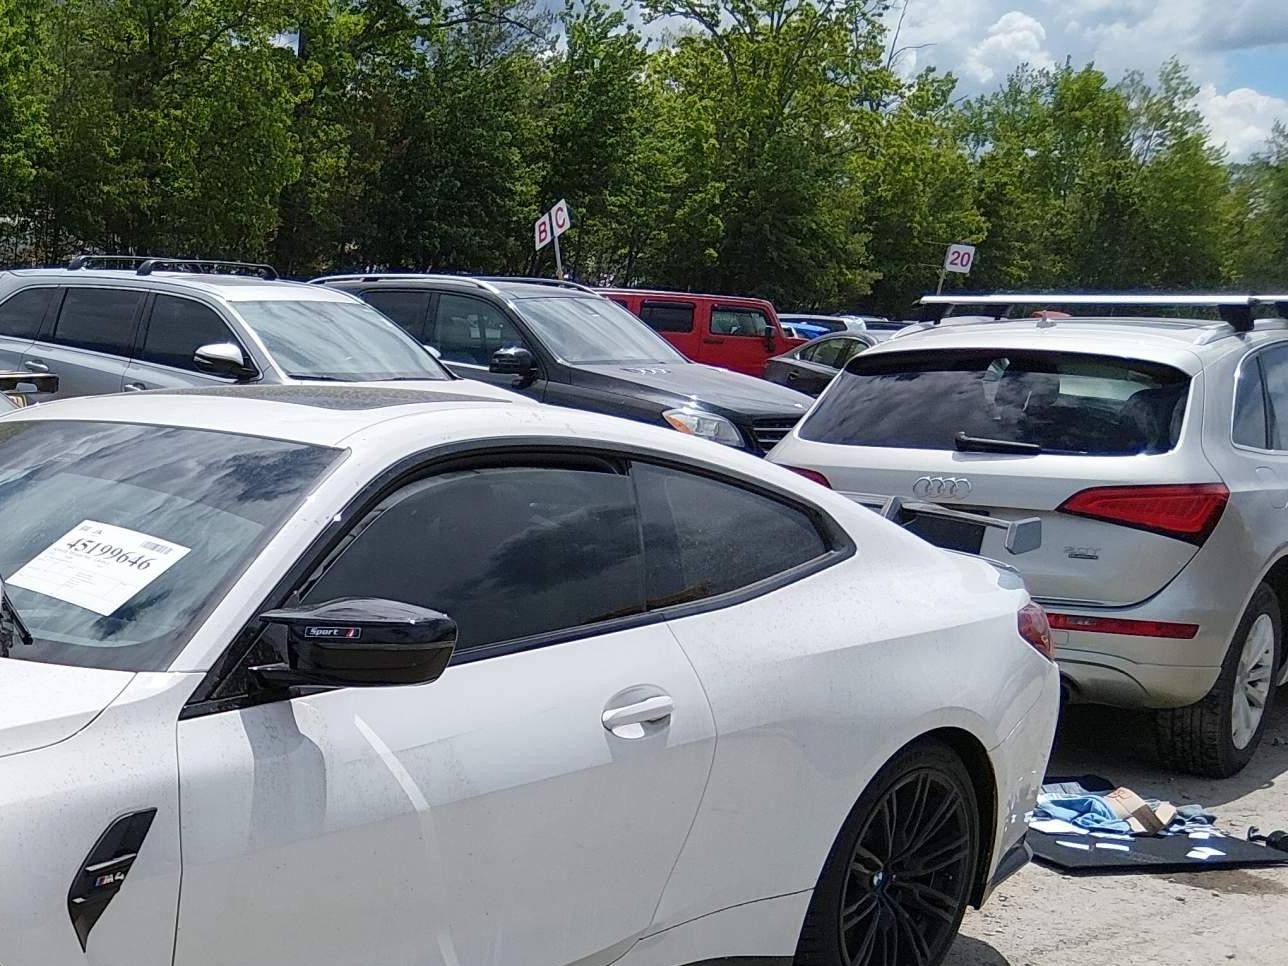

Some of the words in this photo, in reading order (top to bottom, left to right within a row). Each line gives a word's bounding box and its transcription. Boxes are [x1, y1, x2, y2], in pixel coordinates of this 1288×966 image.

[555, 206, 566, 229] C
[538, 221, 548, 244] B
[949, 250, 971, 267] 20
[67, 537, 152, 571] 45199646
[309, 627, 339, 636] Sport
